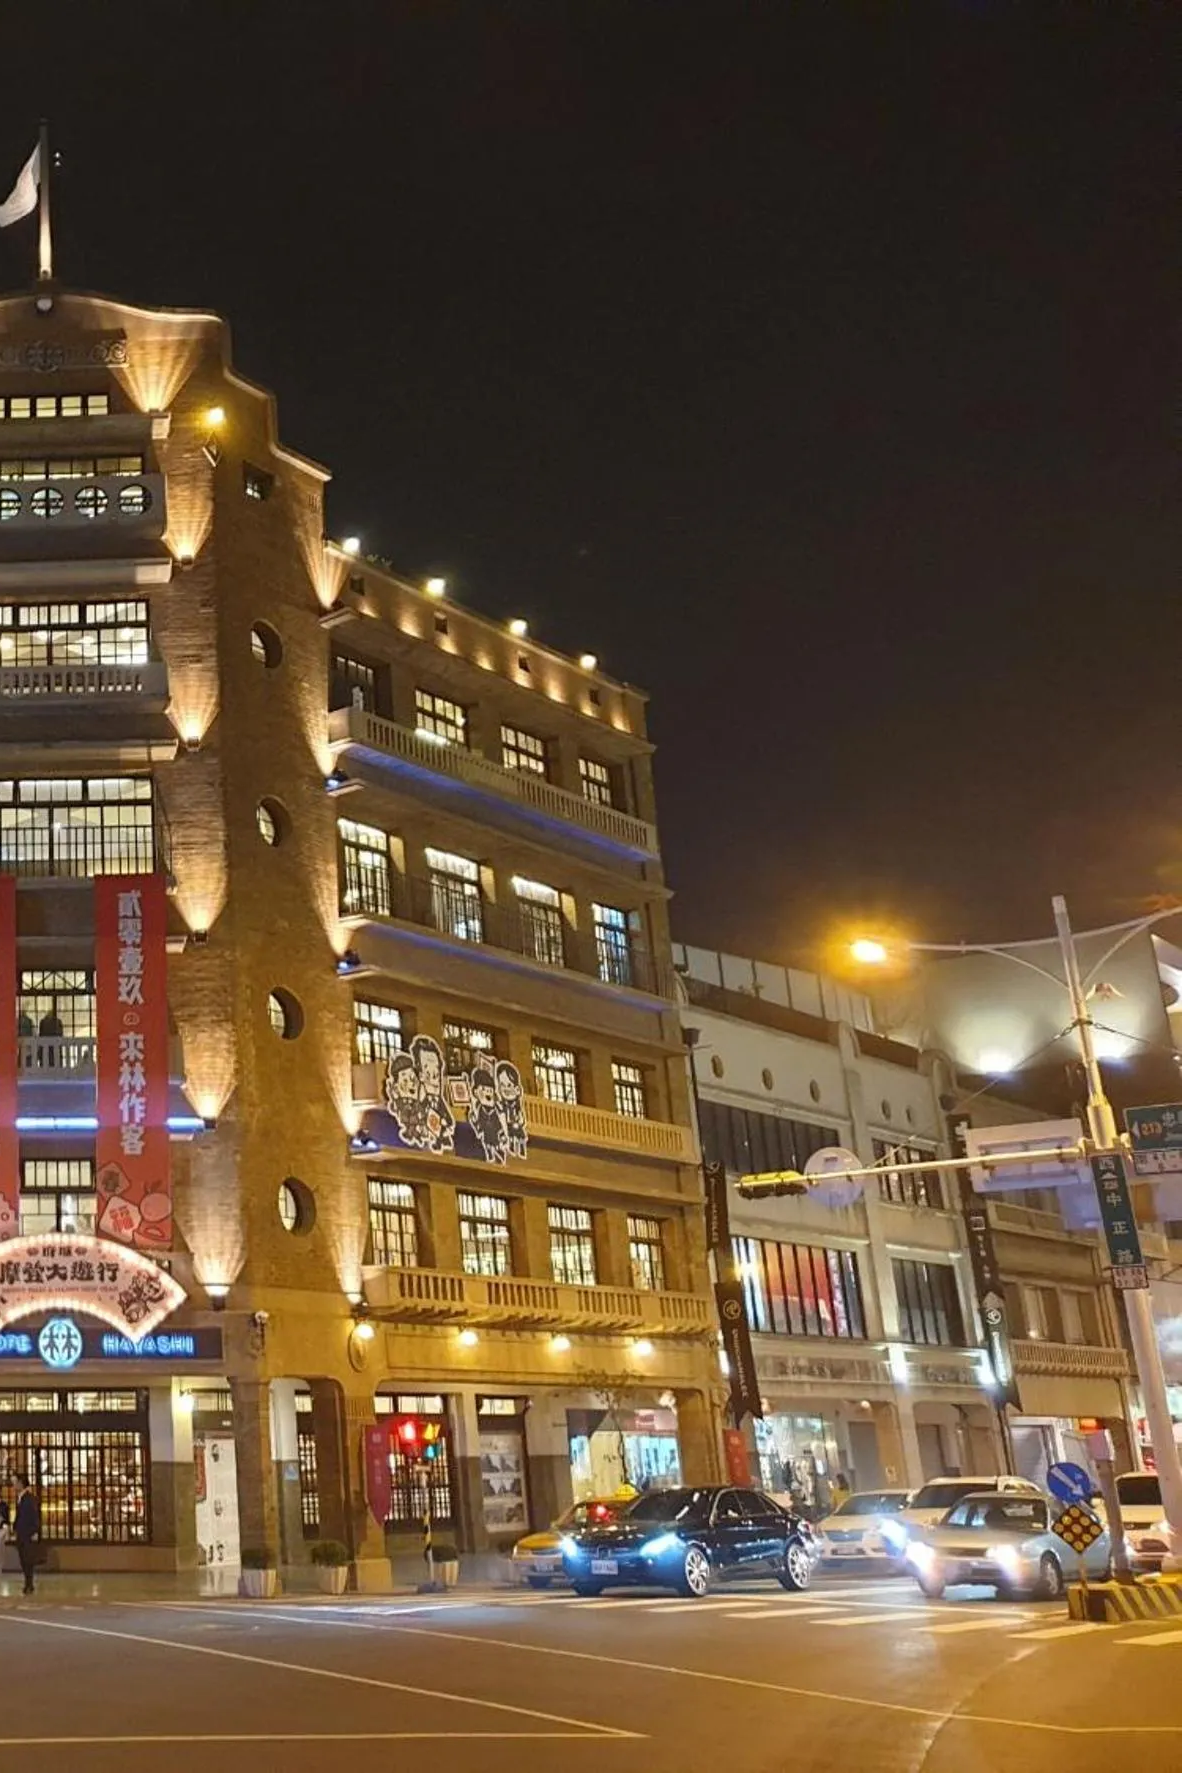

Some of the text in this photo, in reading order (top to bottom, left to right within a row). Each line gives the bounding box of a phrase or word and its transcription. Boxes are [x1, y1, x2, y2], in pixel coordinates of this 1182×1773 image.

[118, 889, 144, 1006] 貳零壹玖
[1105, 1193, 1134, 1264] 中正路
[103, 1333, 195, 1355] HAYASHI
